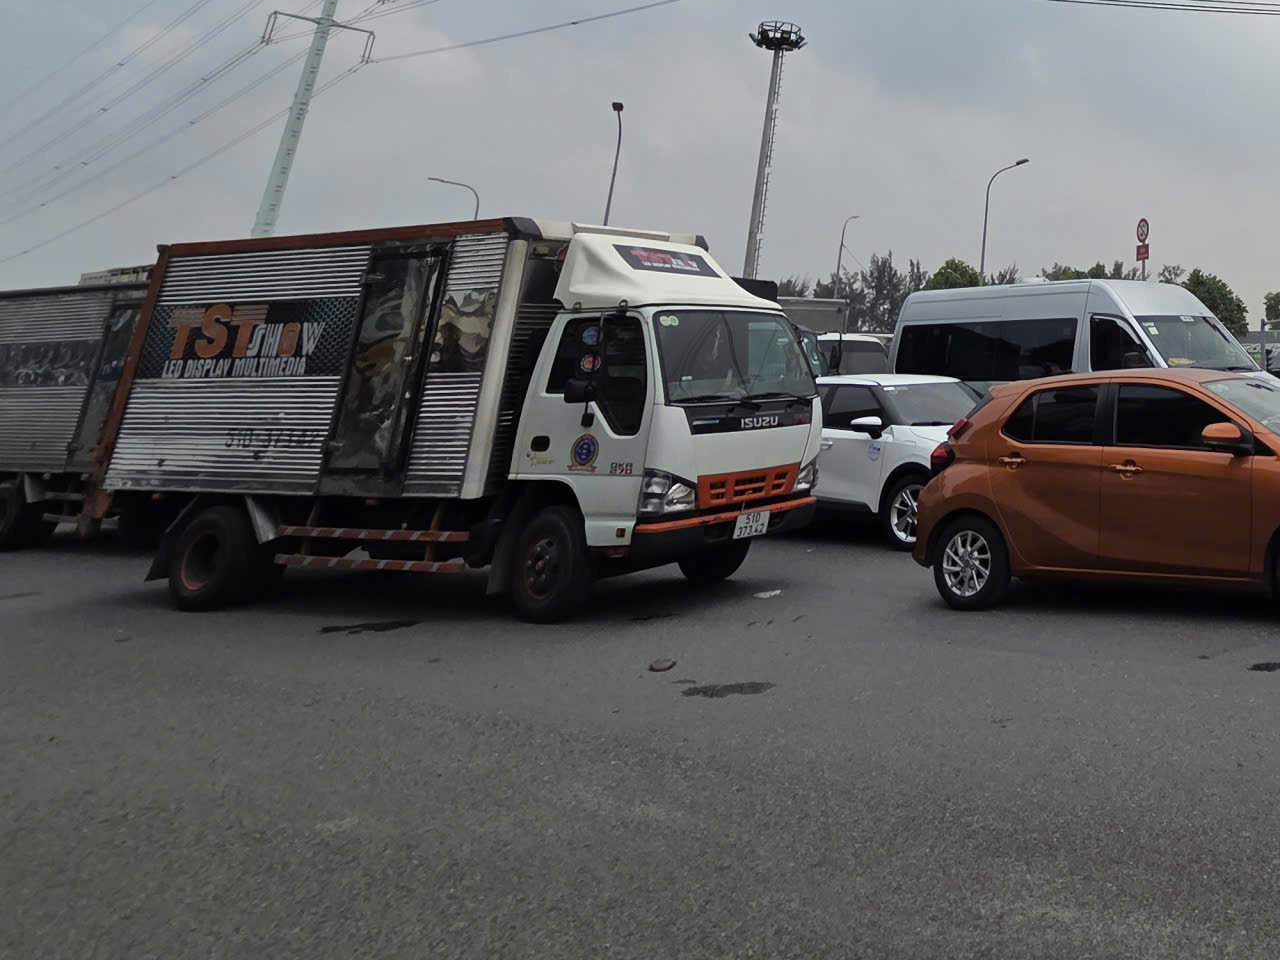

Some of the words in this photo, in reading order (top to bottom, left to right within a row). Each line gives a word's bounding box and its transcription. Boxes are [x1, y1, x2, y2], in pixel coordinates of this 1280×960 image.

[168, 303, 269, 359] TST
[161, 359, 184, 378] LED
[184, 358, 232, 378] DISPLAY
[231, 356, 307, 377] MULTIMEDIA
[741, 416, 778, 428] ISUZU
